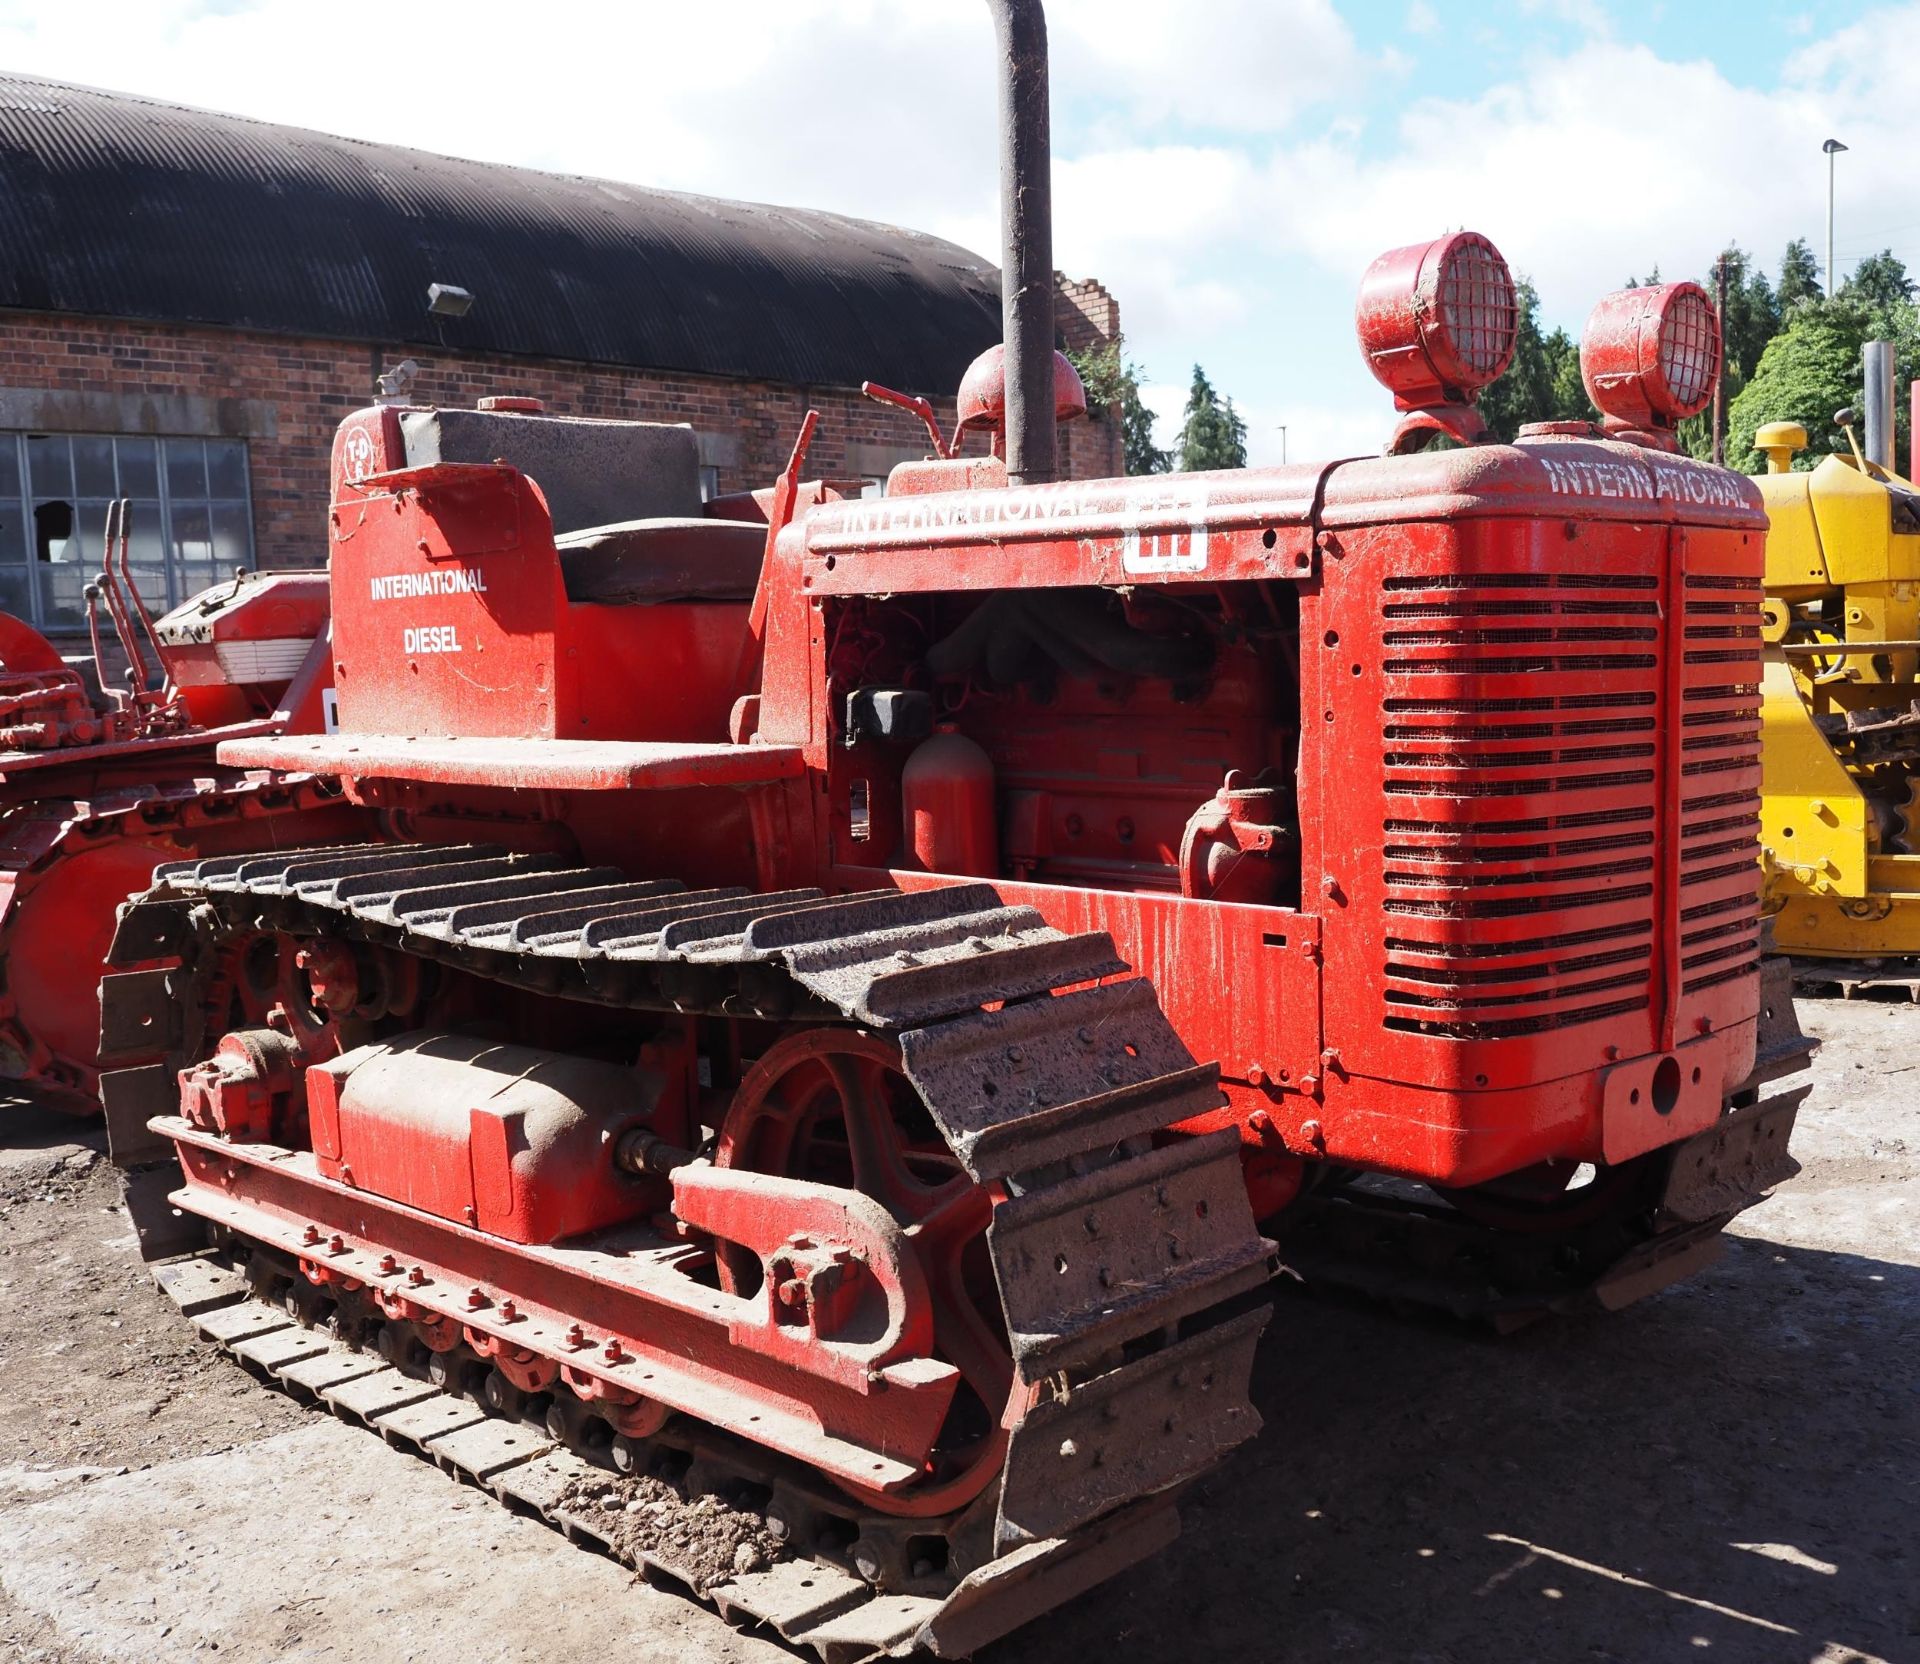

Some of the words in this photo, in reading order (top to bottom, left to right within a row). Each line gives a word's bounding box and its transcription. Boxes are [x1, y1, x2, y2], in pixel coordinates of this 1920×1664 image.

[1540, 458, 1750, 509] INTERNATIONAL
[842, 485, 1097, 534] INTERNATIONAL
[370, 568, 488, 600] INTERNATIONAL
[404, 626, 462, 654] DIESEL
